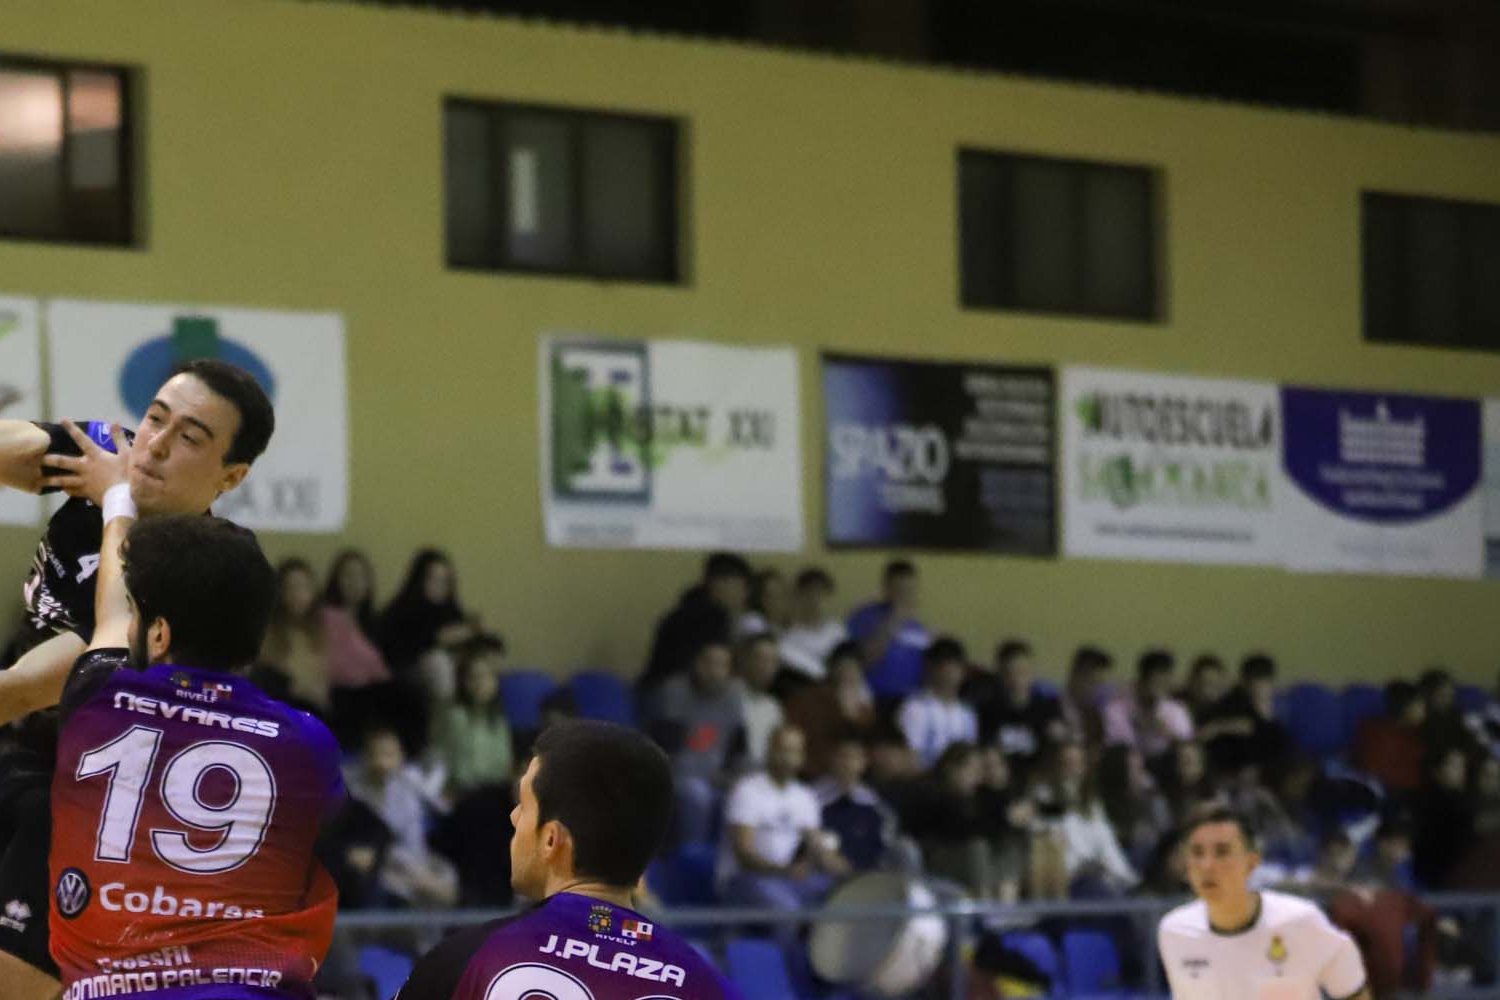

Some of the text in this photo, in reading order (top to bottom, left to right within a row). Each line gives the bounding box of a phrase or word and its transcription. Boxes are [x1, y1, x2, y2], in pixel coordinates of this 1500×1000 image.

[114, 692, 279, 738] NEVARES
[75, 723, 278, 876] 19
[162, 968, 283, 989] PALENCIA
[539, 934, 686, 987] J.PLAZA
